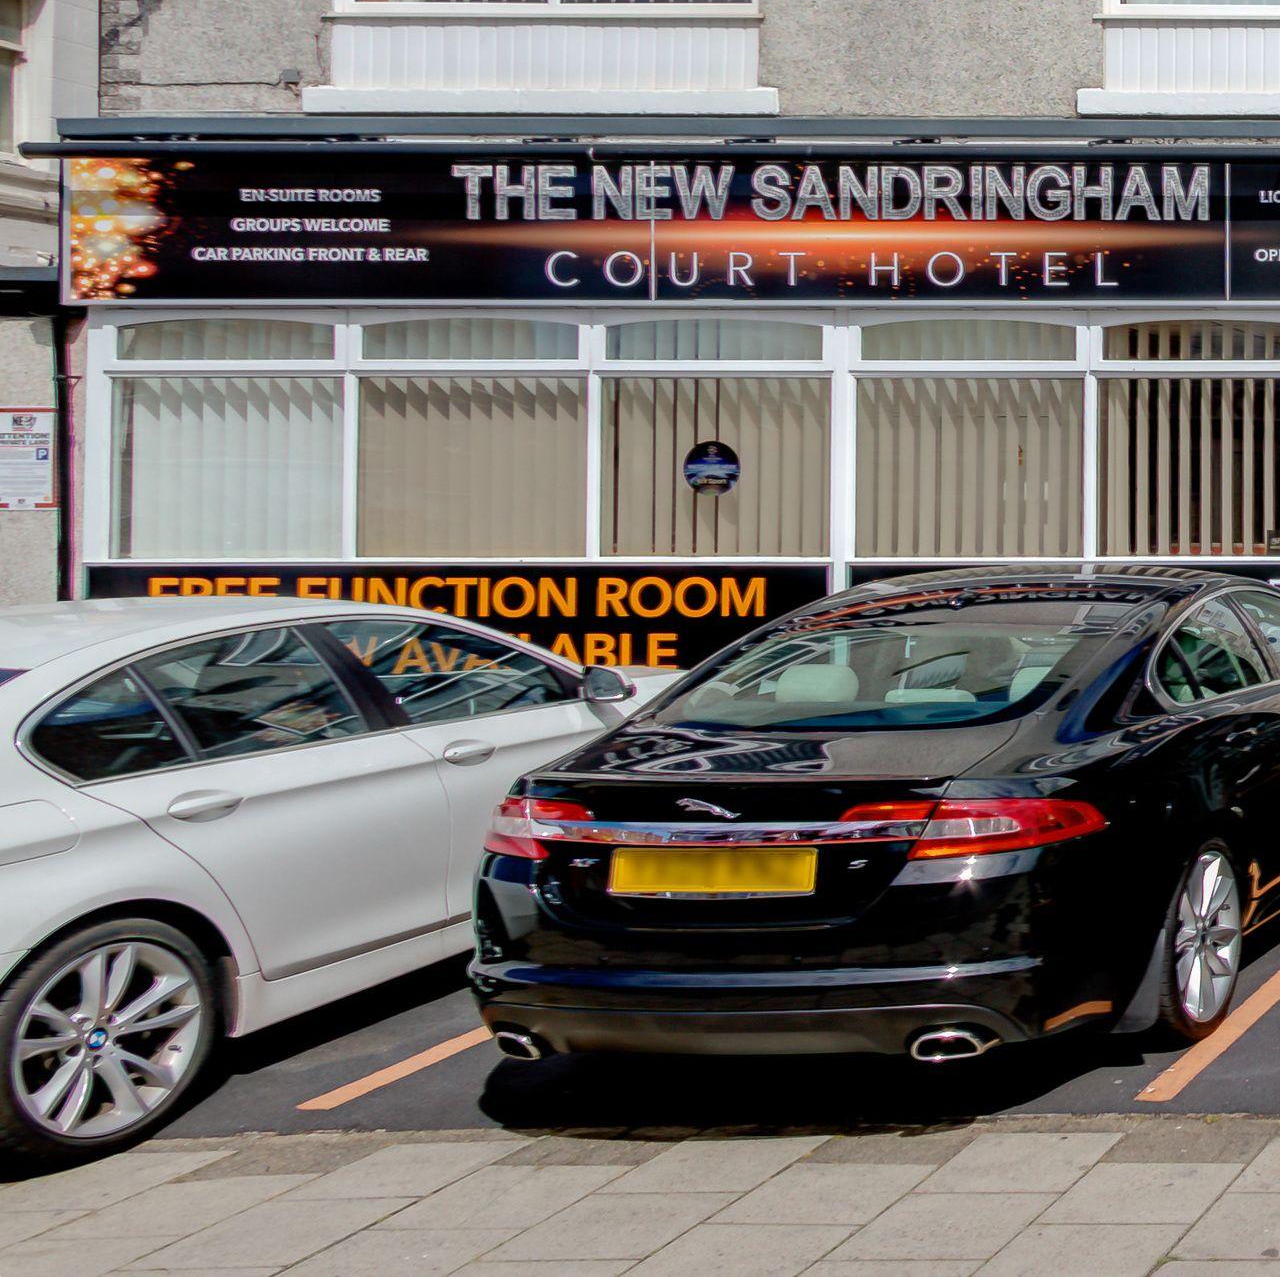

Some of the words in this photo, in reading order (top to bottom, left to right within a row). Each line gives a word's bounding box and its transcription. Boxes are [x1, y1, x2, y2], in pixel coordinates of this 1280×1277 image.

[239, 188, 317, 203] EN-SUITE
[316, 188, 382, 203] ROOMS
[450, 164, 578, 221] THE
[591, 164, 736, 221] NEW
[750, 164, 1211, 222] SANDRINGHAM
[230, 217, 302, 232] GROUPS
[302, 217, 392, 232] WELCOME
[191, 247, 229, 262] CAR
[230, 247, 305, 262] PARKING
[308, 247, 365, 262] FRONT
[366, 247, 382, 262] &
[383, 247, 430, 262] REAR
[543, 250, 807, 288] COURT
[867, 250, 1120, 288] HOTEL
[595, 576, 768, 619] ROOM
